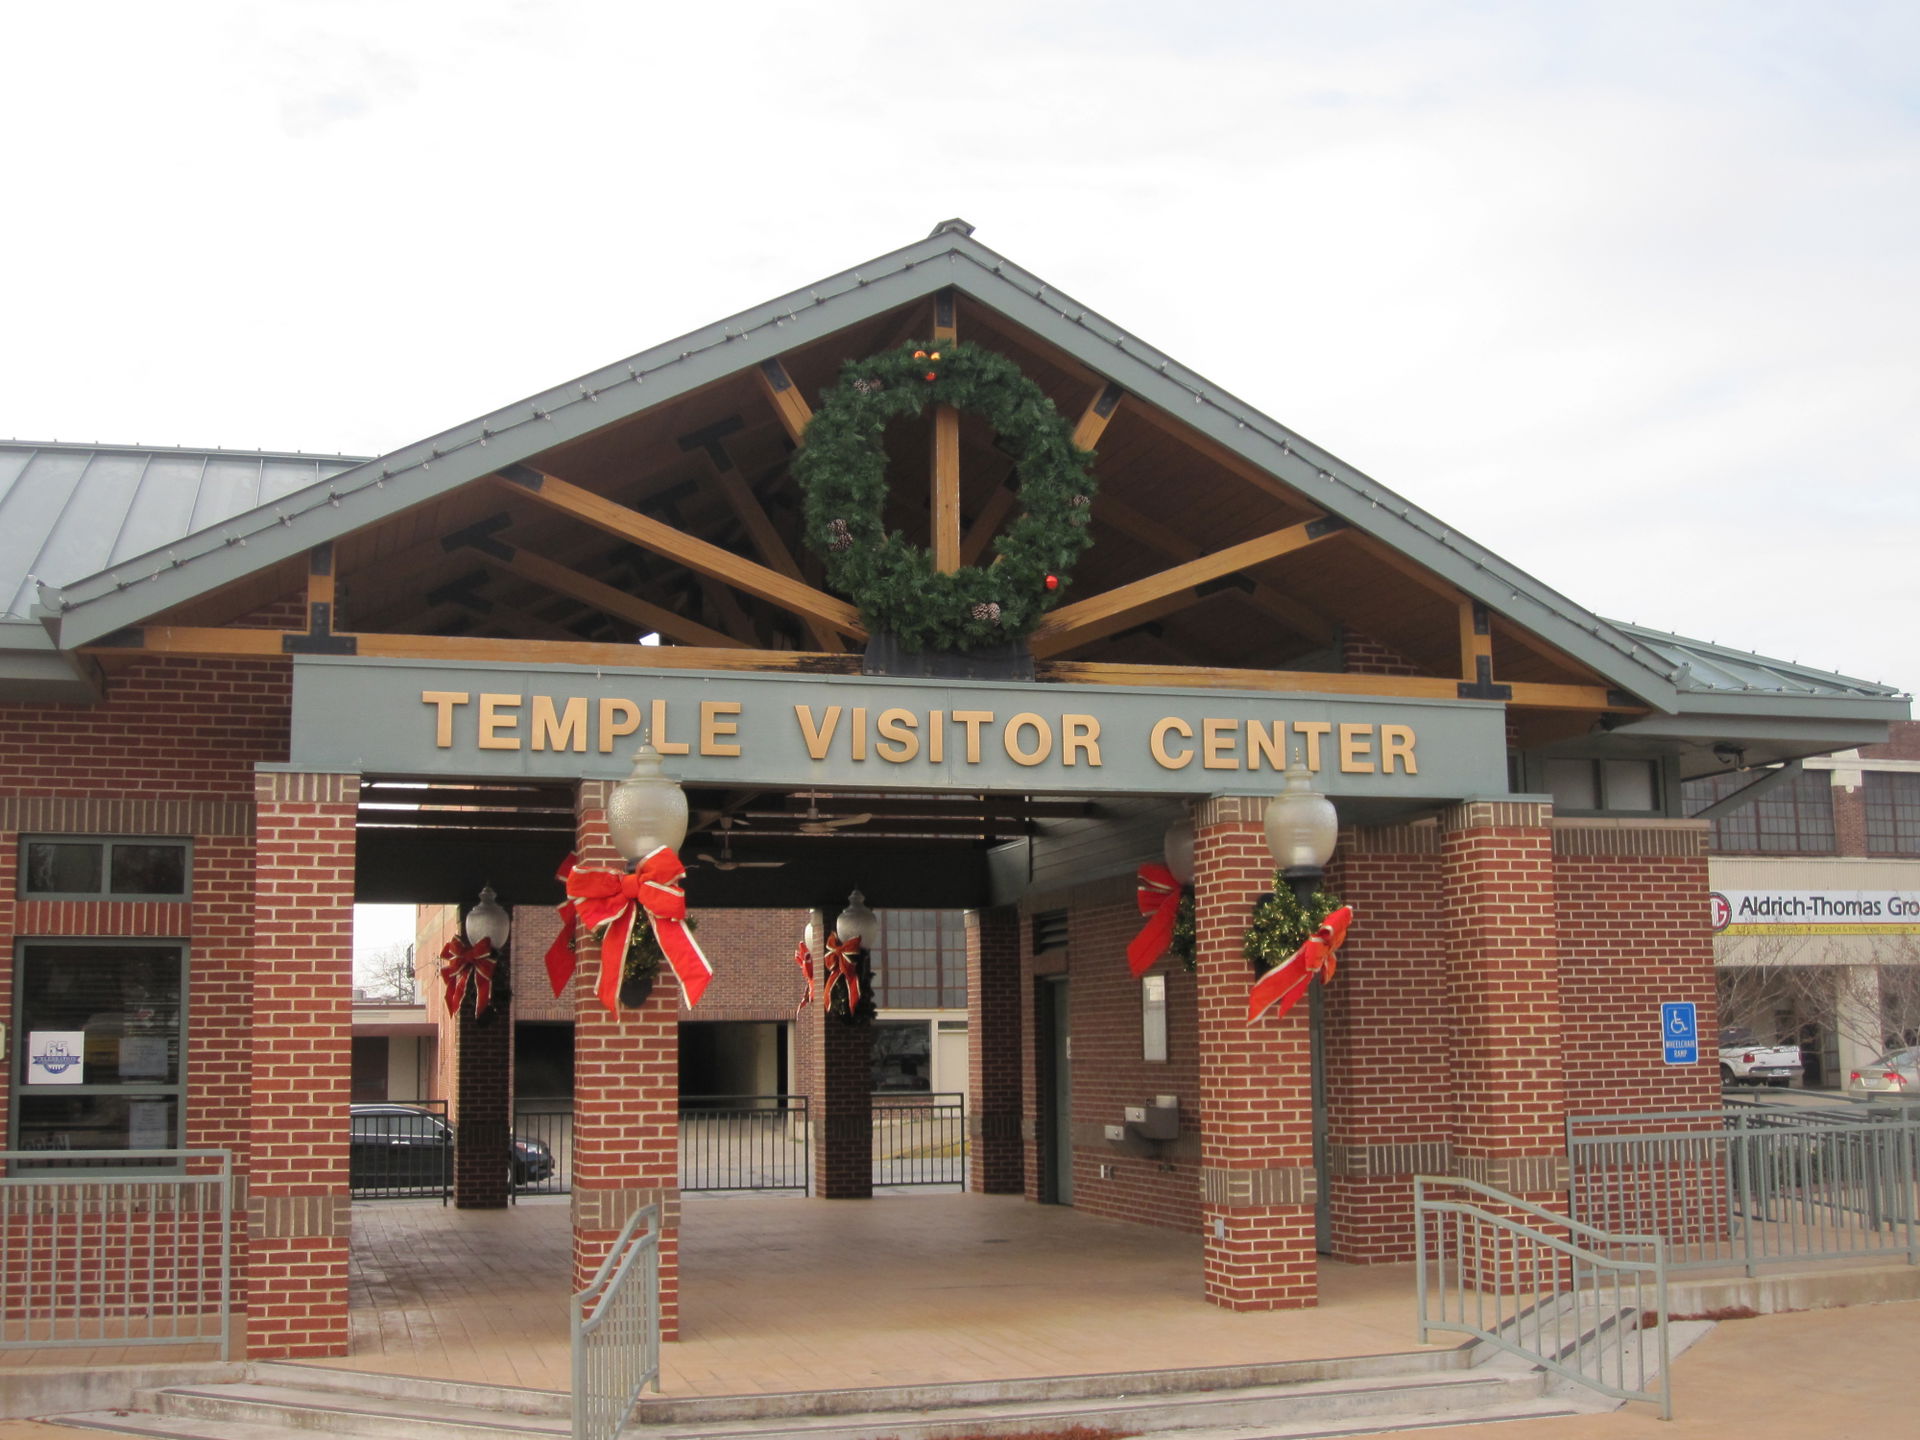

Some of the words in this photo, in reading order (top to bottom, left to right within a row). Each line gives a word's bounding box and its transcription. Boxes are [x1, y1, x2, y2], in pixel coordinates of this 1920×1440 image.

[422, 690, 741, 757] TEMPLE
[794, 704, 1103, 766] VISITOR
[1150, 715, 1418, 775] CENTER
[1739, 896, 1881, 916] Aldrich-Thomas
